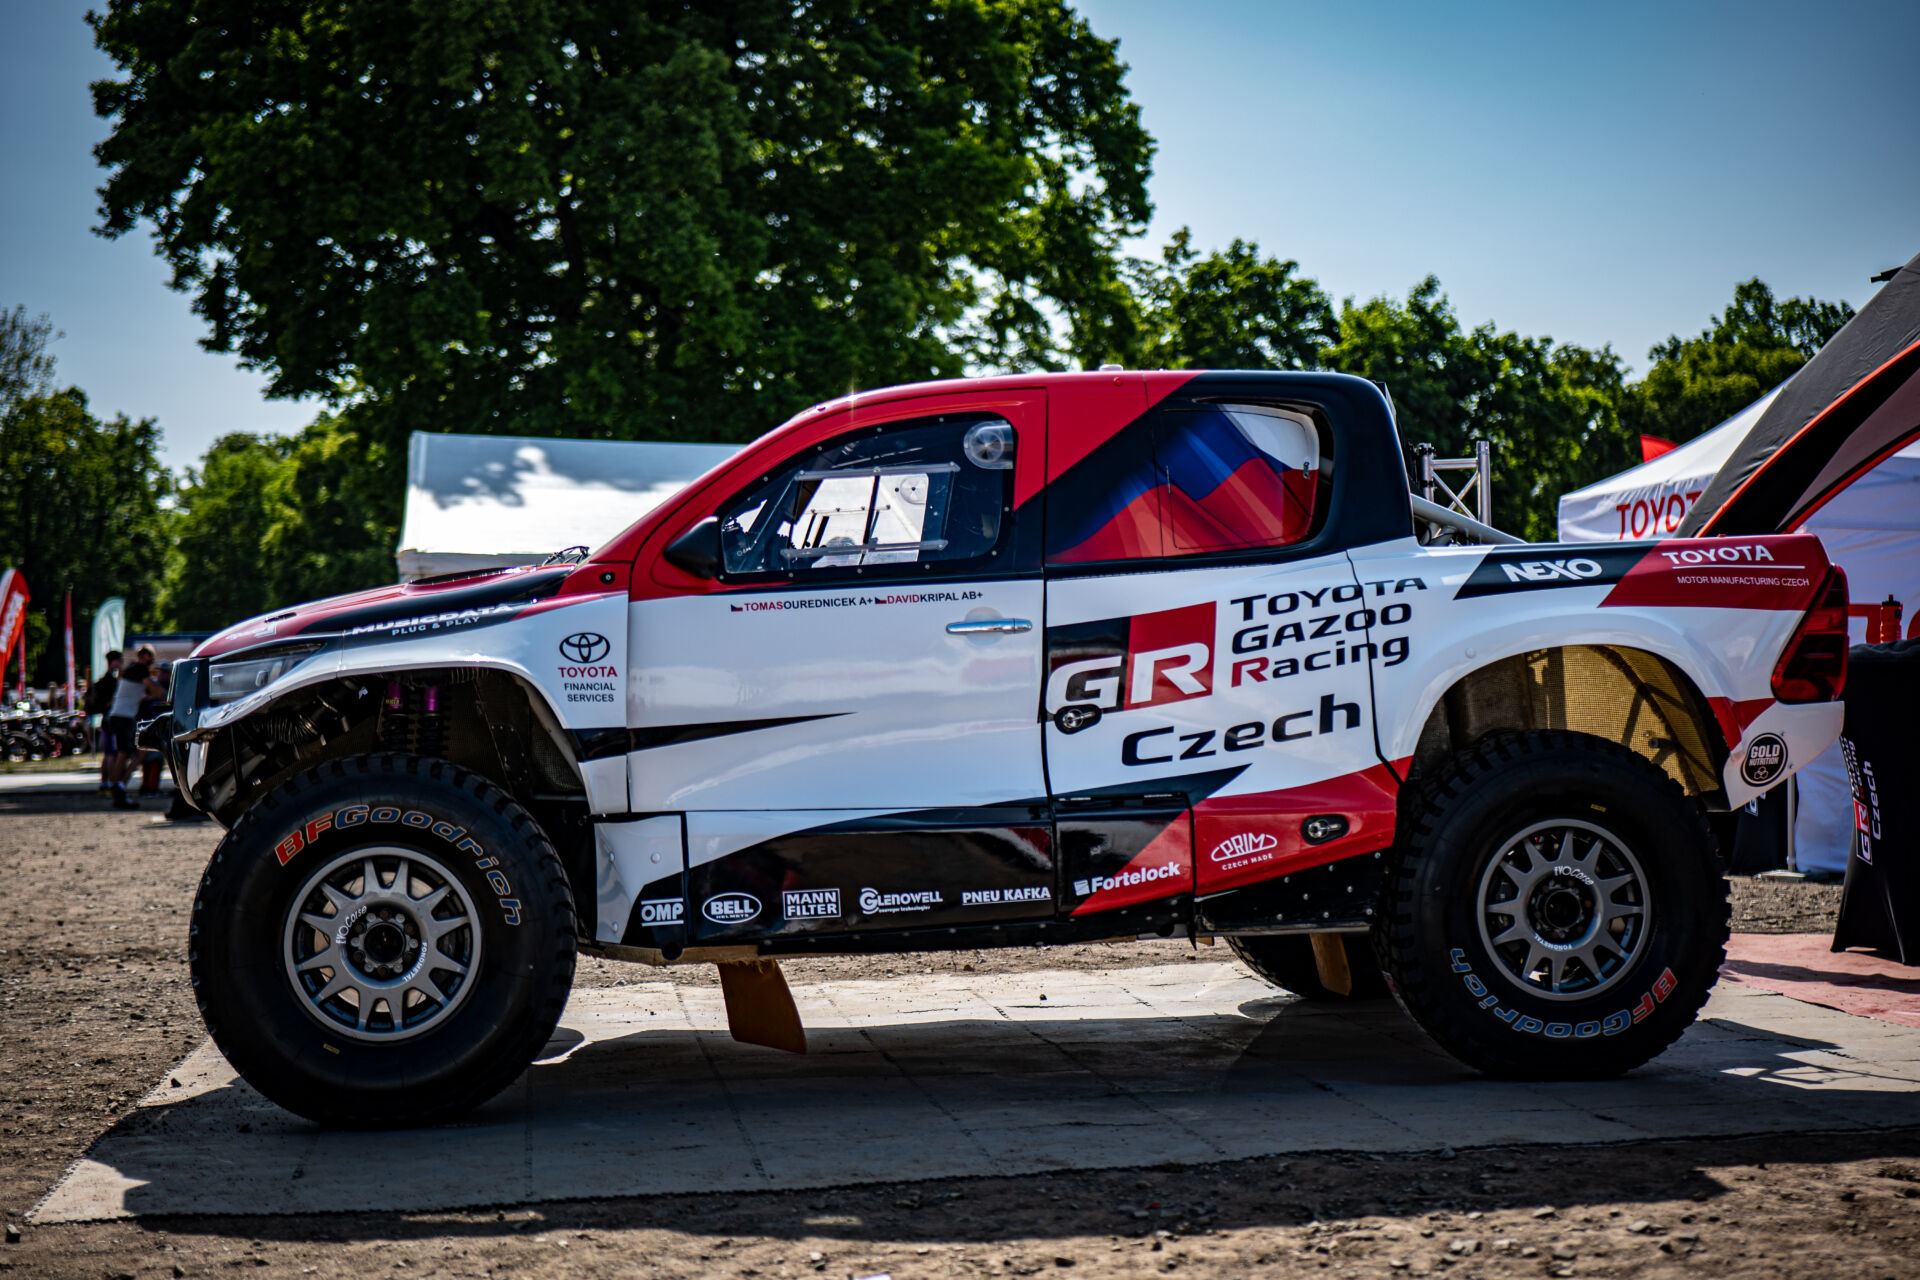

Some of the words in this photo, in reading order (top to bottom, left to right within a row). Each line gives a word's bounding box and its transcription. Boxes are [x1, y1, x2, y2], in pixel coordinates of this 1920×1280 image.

[1616, 491, 1703, 540] TOYOT
[1661, 545, 1774, 564] TOYOTA
[1501, 558, 1603, 583] NEXO
[1677, 576, 1709, 585] MOTOR
[1710, 576, 1780, 586] MANUFACTURING
[1781, 578, 1810, 586] CZECH
[859, 596, 874, 607] A+
[961, 591, 983, 601] AB+
[1230, 577, 1427, 621] TOYOTA
[352, 604, 513, 635] MUSICDATA
[392, 624, 427, 636] PLUG
[432, 622, 441, 630] &
[446, 616, 480, 628] PLAY
[1231, 603, 1412, 655] GAZOO
[557, 666, 618, 679] TOYOTA
[1231, 636, 1410, 688] Racing
[564, 682, 616, 692] FINANCIAL
[1046, 642, 1210, 713] GR
[567, 694, 615, 703] SERVICES
[1122, 693, 1361, 767] Czech
[1748, 757, 1780, 767] NUTRITION
[1750, 744, 1780, 759] GOLD
[1863, 760, 1881, 840] Czech
[1858, 804, 1872, 861] GR
[1219, 832, 1267, 858] PRIM
[274, 804, 523, 927] BFGoodrich
[1221, 859, 1249, 871] CZECH
[1250, 853, 1273, 864] MADE
[1091, 861, 1181, 893] Fortelock
[787, 891, 836, 904] MANN
[962, 891, 999, 904] PNEU
[1004, 887, 1051, 901] KAFKA
[641, 900, 683, 921] OMP
[710, 900, 754, 915] BELL
[787, 903, 837, 917] FILTER
[1450, 948, 1678, 1038] BFGoodrich
